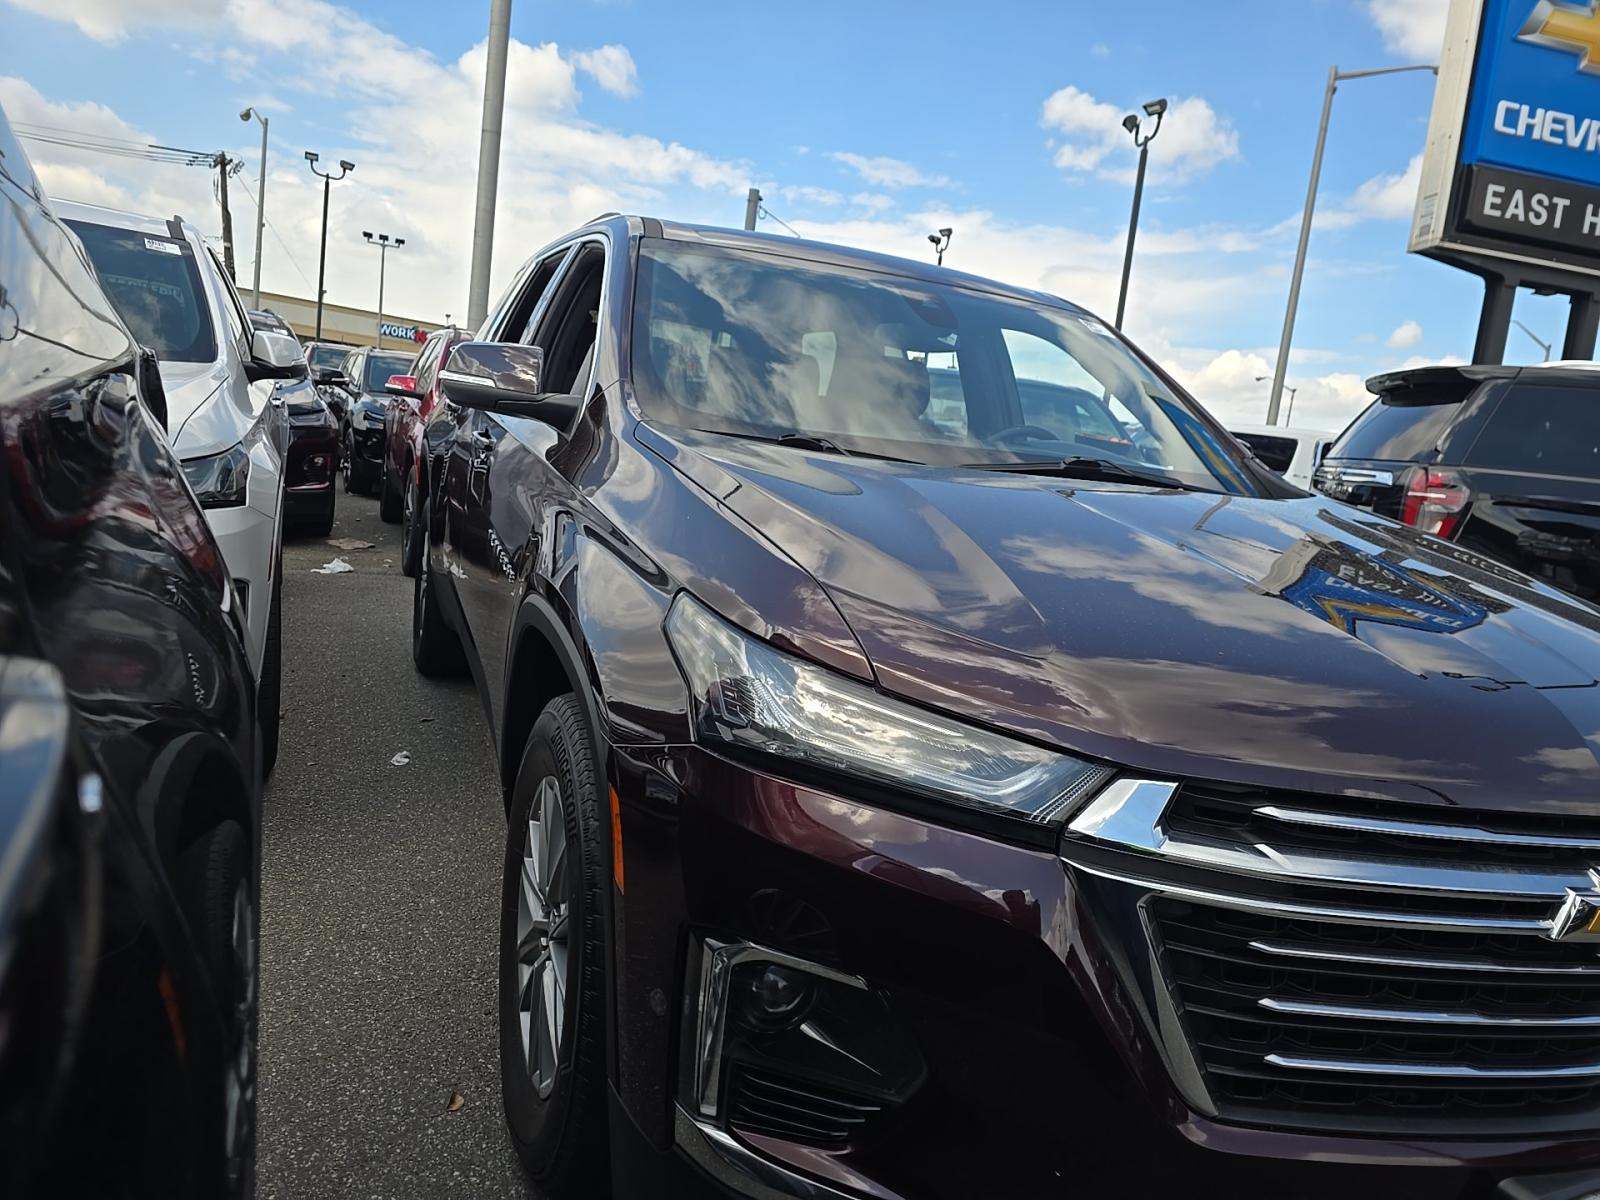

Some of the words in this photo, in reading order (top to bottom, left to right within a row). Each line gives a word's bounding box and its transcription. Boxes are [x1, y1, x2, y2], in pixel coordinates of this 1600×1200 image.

[1483, 183, 1570, 228] EAST
[1582, 203, 1600, 236] H
[381, 324, 415, 339] WORK
